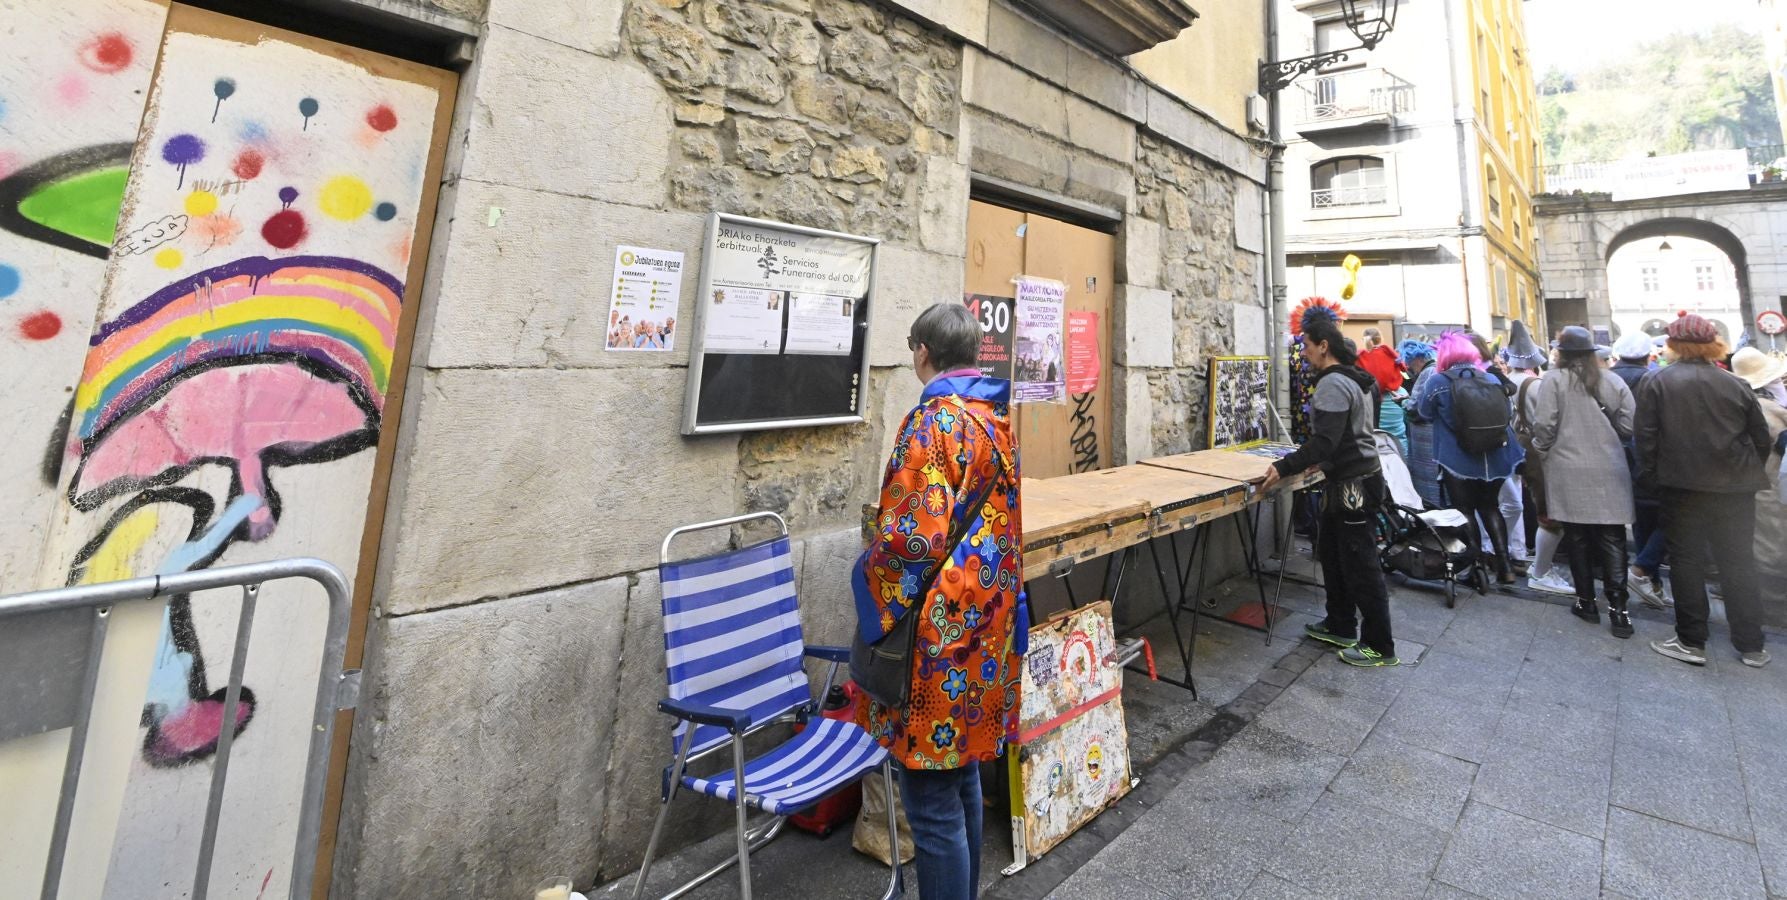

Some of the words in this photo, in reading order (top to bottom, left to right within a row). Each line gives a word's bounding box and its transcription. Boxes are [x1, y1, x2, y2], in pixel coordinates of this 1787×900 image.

[754, 233, 796, 248] Ehorzketa
[782, 255, 819, 268] Servicios
[782, 266, 826, 280] Funerarios
